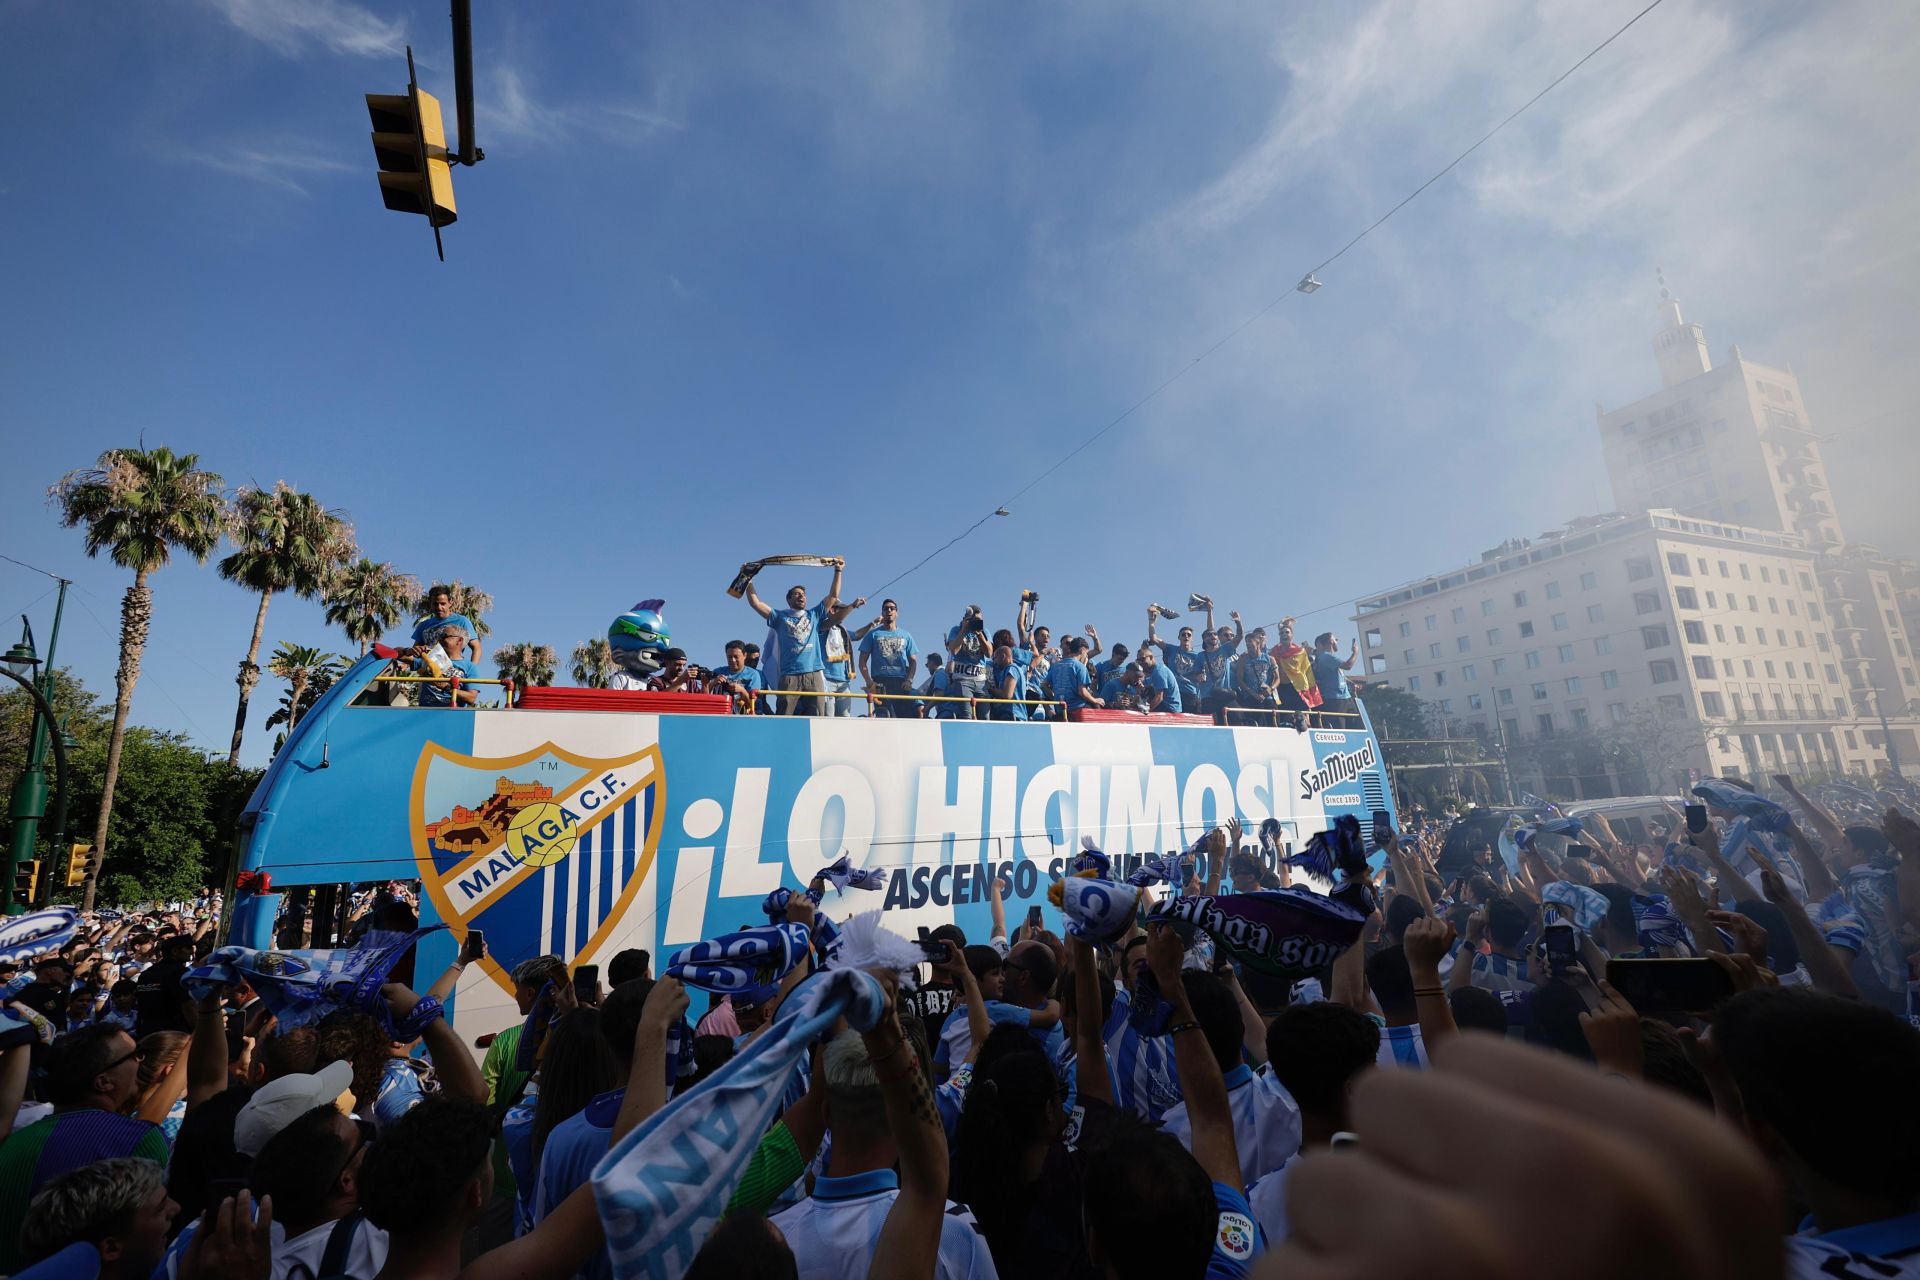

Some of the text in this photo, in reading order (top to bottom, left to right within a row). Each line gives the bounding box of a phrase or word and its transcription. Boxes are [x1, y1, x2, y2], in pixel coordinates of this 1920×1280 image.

[1315, 733, 1345, 741] CERVEZAS
[539, 761, 558, 771] TM
[458, 773, 627, 899] MALAGA C.F.
[883, 859, 1038, 911] ASCENSO
